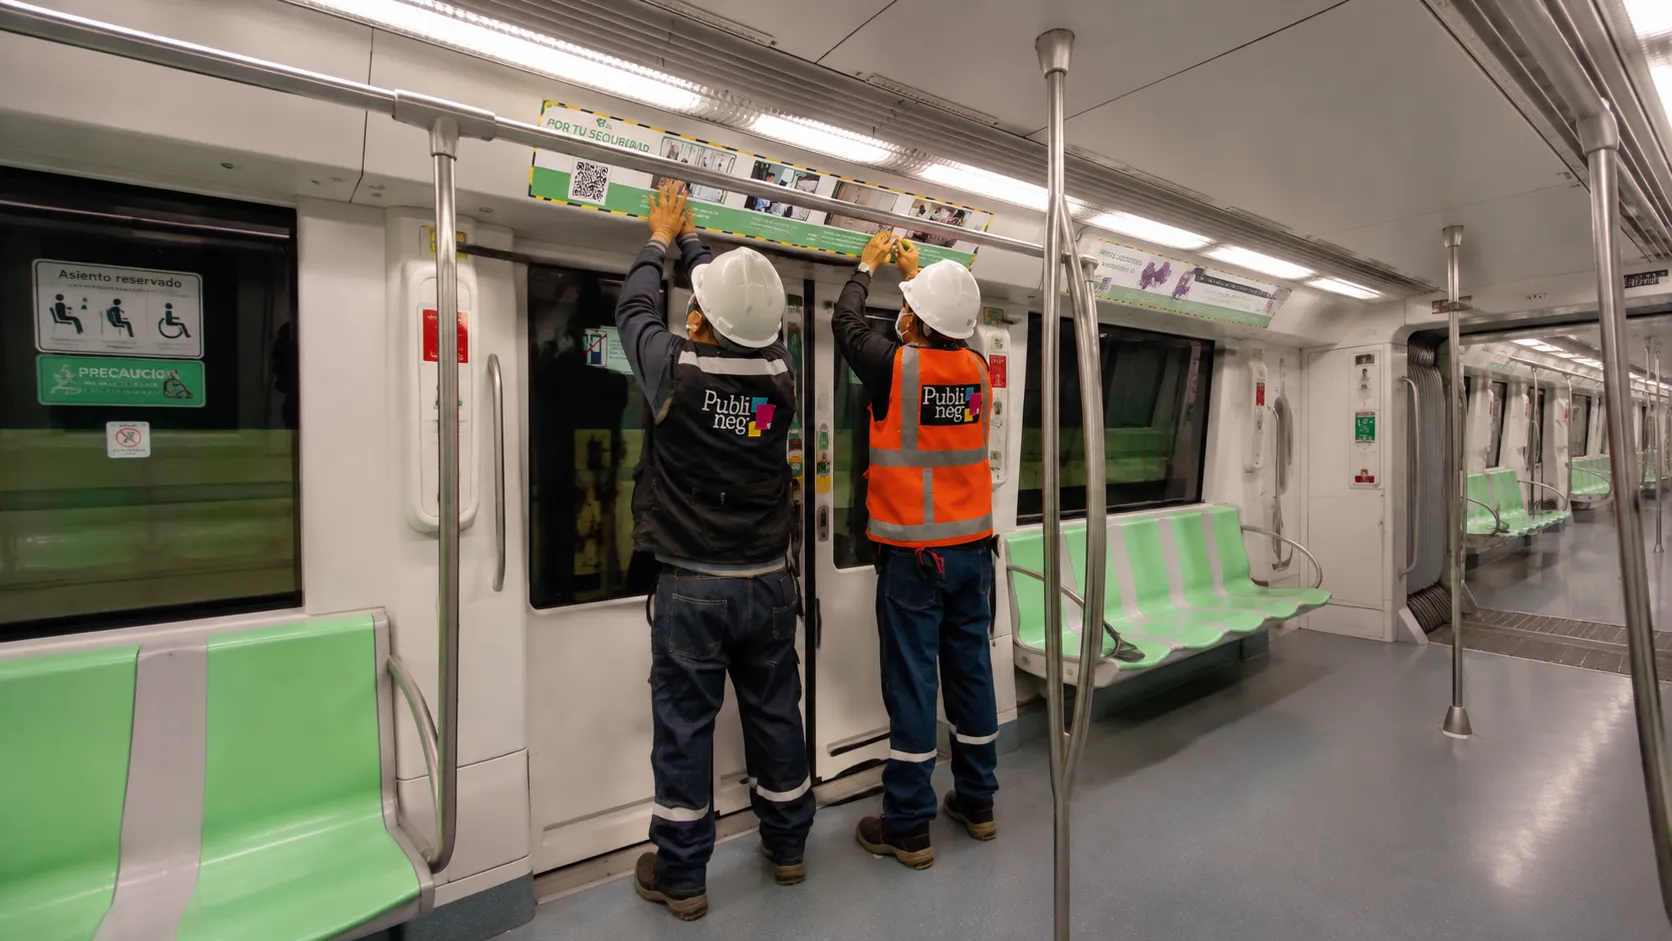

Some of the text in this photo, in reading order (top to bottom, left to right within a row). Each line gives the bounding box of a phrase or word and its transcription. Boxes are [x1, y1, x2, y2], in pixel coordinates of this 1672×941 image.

[547, 118, 569, 133] POR
[573, 124, 587, 137] TU
[58, 269, 182, 289] Asiento reservado
[702, 389, 750, 416] Publi
[922, 386, 965, 405] Publi
[935, 406, 965, 422] neg
[713, 414, 750, 435] neg
